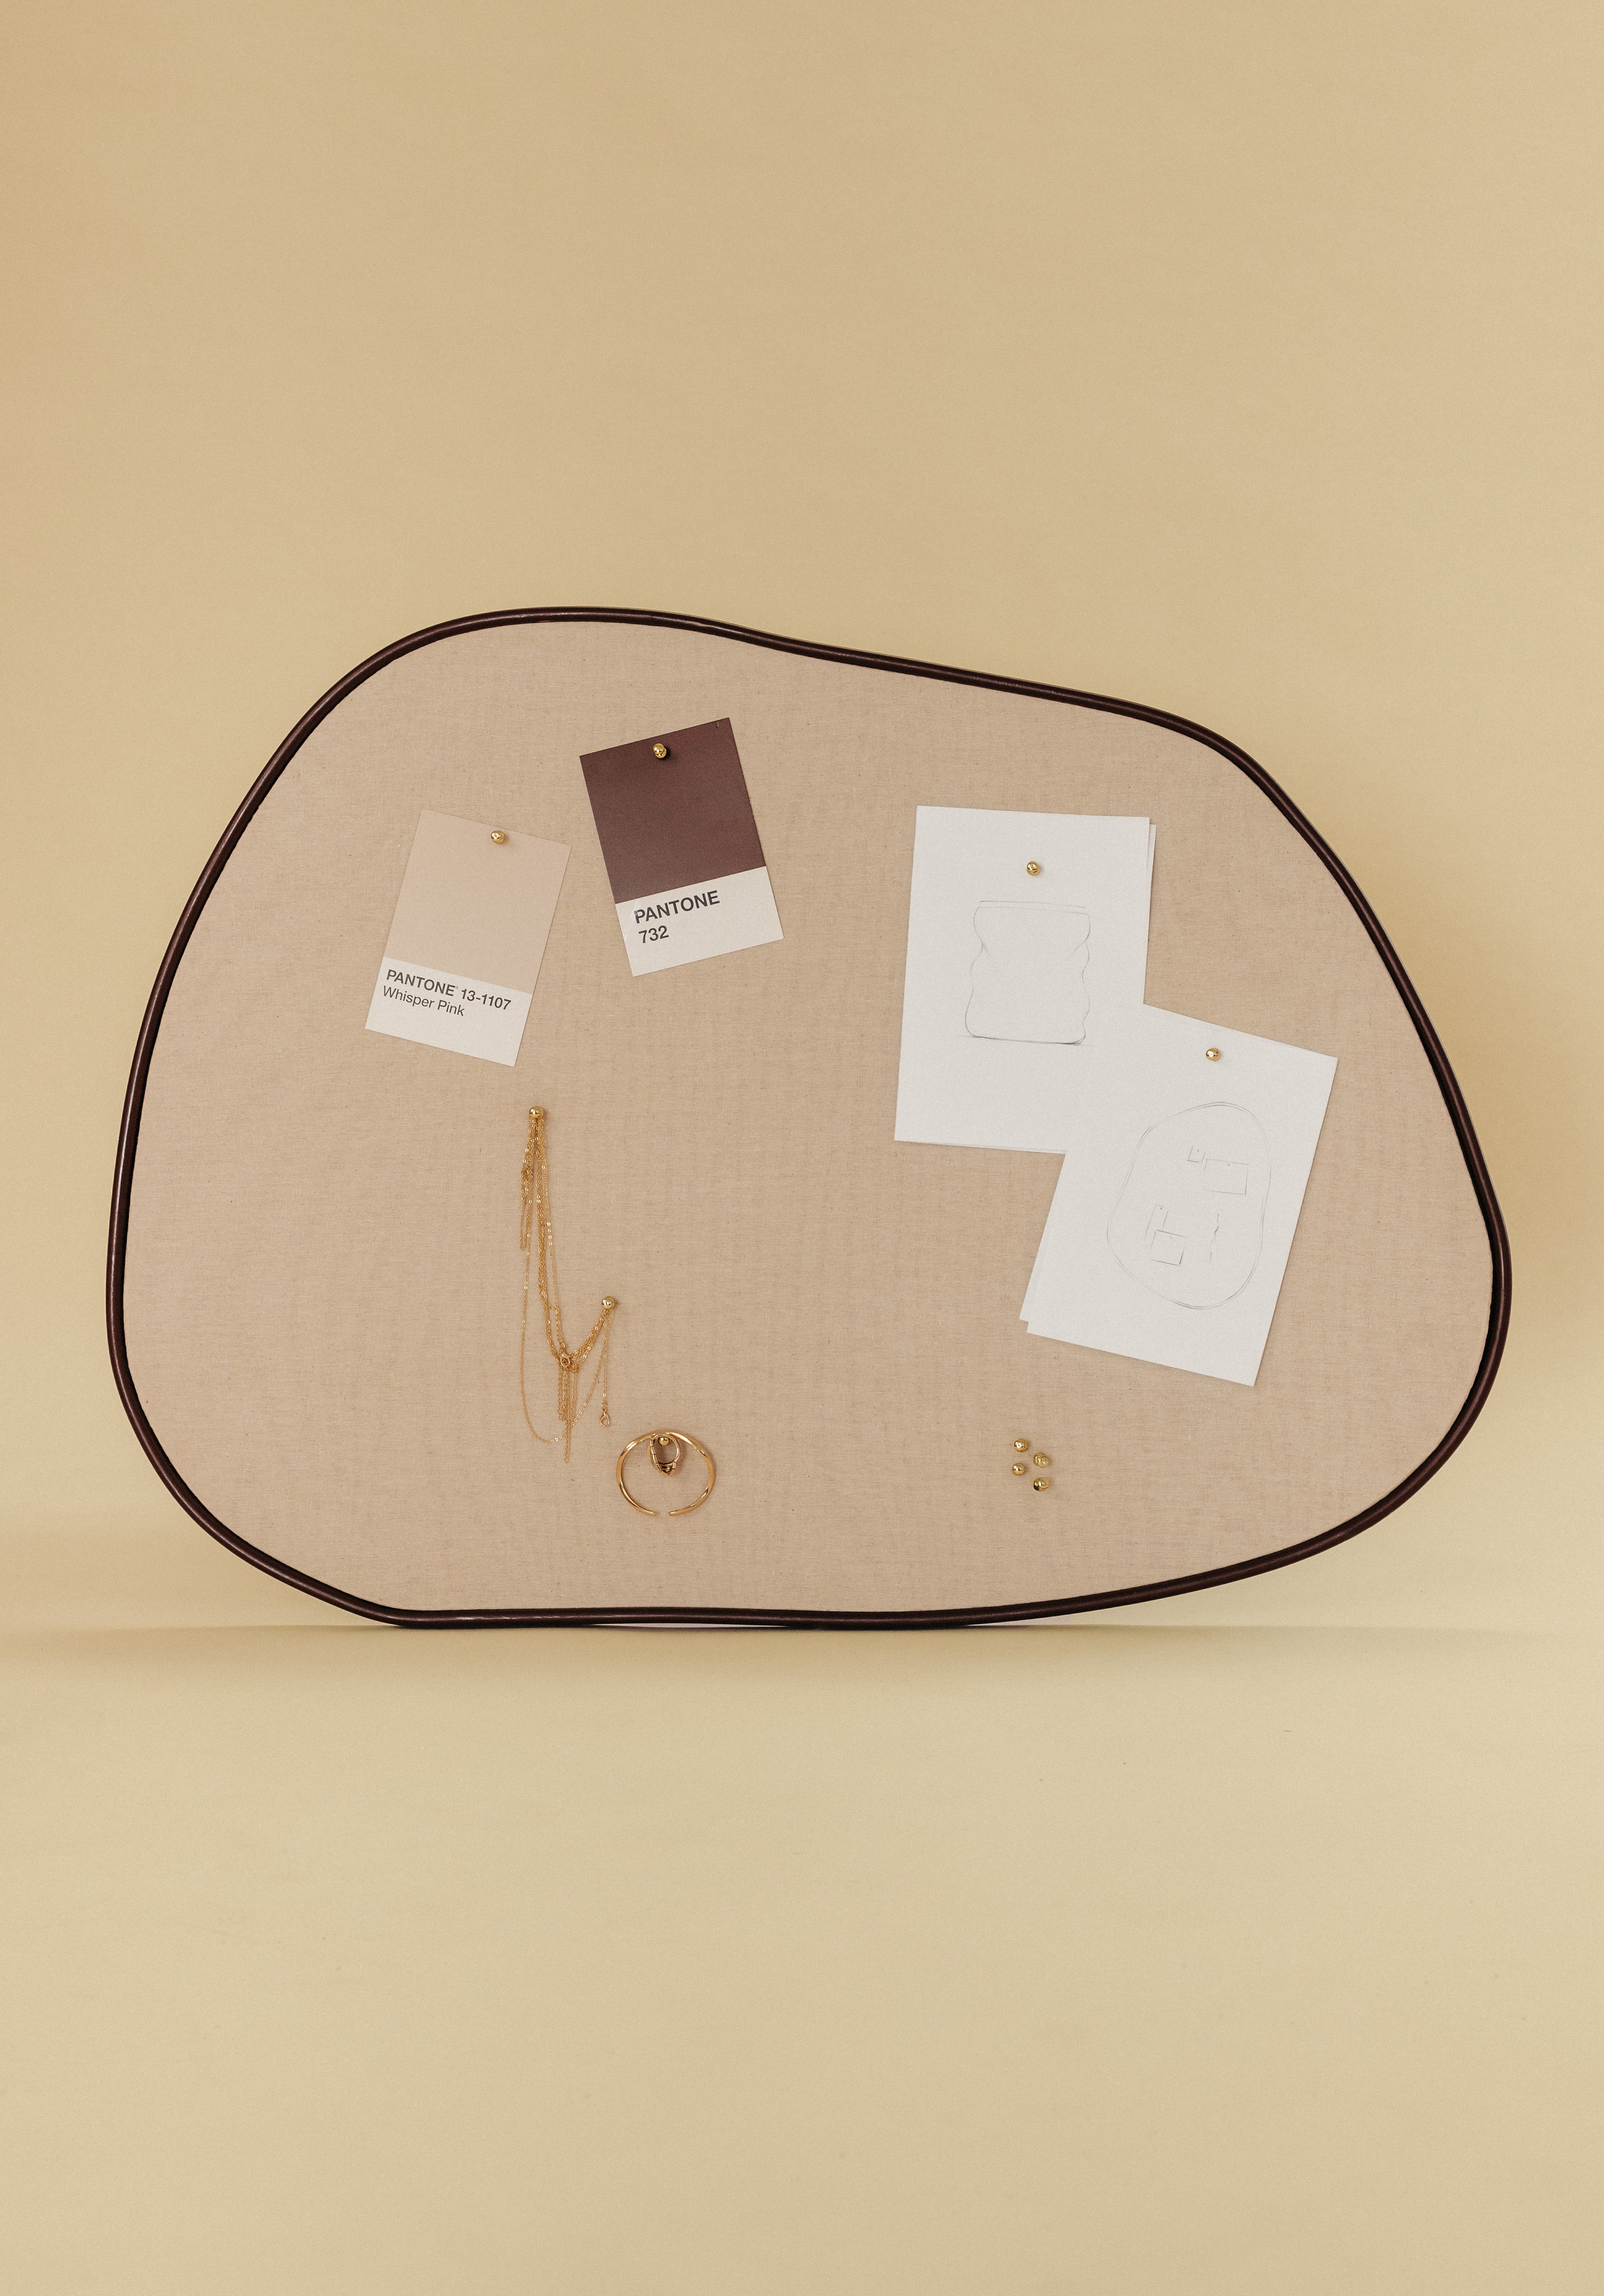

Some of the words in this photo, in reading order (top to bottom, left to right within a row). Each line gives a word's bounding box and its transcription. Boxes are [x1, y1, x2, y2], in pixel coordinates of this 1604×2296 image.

[634, 890, 720, 923] PANTONE
[638, 925, 669, 944] 732
[383, 985, 435, 1008] Whisper
[437, 1000, 465, 1016] Pink
[386, 969, 456, 997] PANTONE
[461, 989, 512, 1010] 13-1107
